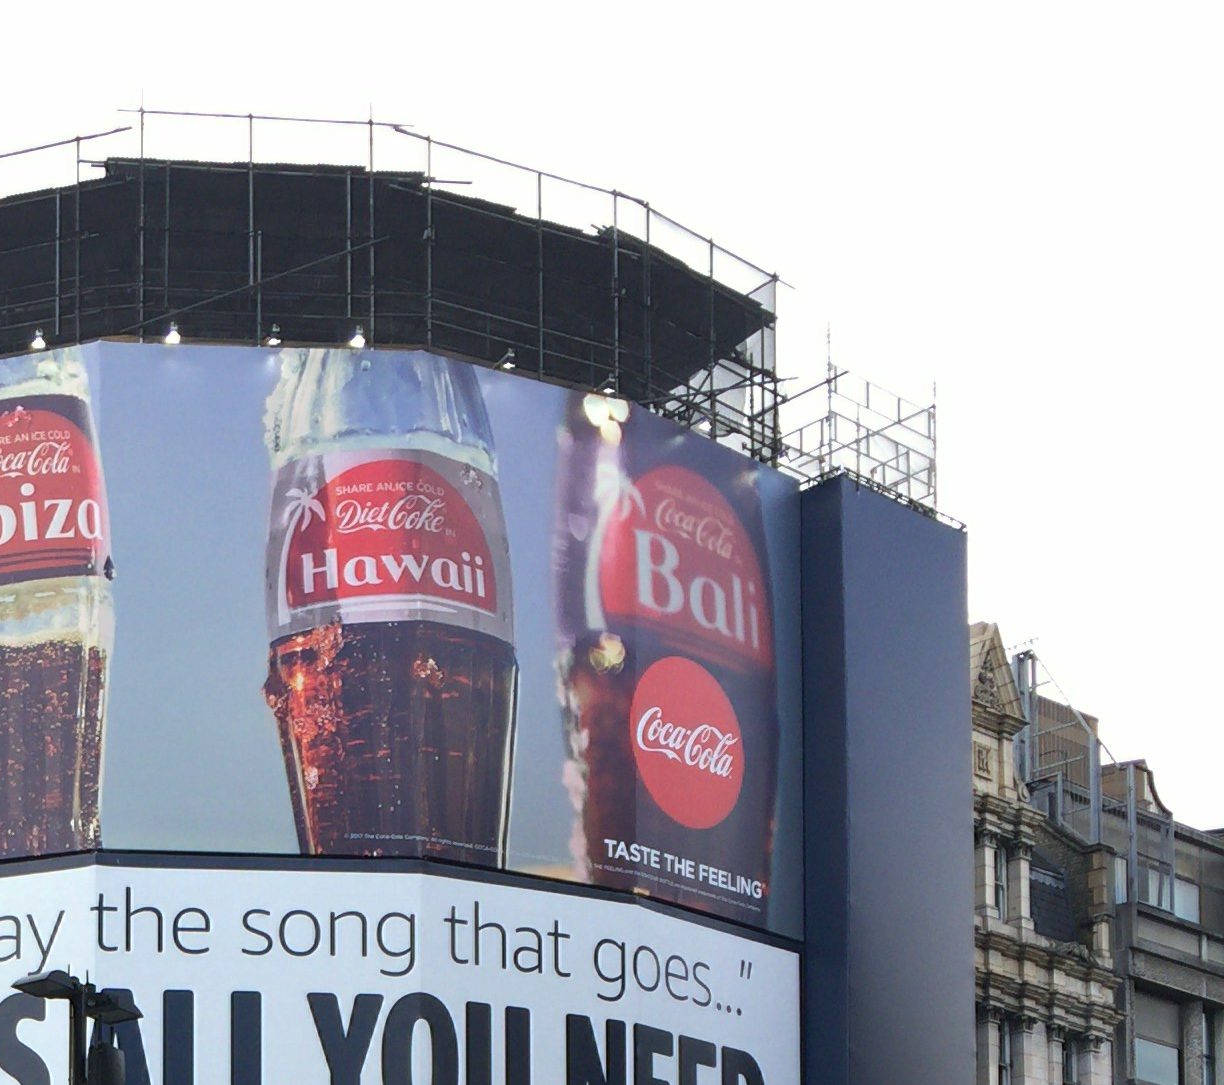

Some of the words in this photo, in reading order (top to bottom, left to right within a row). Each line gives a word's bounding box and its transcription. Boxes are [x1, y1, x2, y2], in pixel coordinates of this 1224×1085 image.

[14, 432, 30, 443] AN
[31, 431, 46, 441] ICE
[47, 430, 71, 440] COLD
[335, 483, 373, 496] SHARE
[376, 483, 394, 492] AN
[395, 481, 413, 492] ICE
[416, 482, 445, 496] COLD
[336, 500, 390, 534] Diet
[388, 494, 447, 533] Coke
[301, 548, 486, 598] Hawaii
[634, 528, 760, 649] Bali
[637, 706, 739, 777] Coca-Cola
[604, 838, 661, 869] TASTE
[663, 852, 695, 880] THE
[698, 863, 764, 899] FEELING
[89, 887, 211, 955] the
[241, 906, 417, 977] song
[444, 901, 572, 978] that
